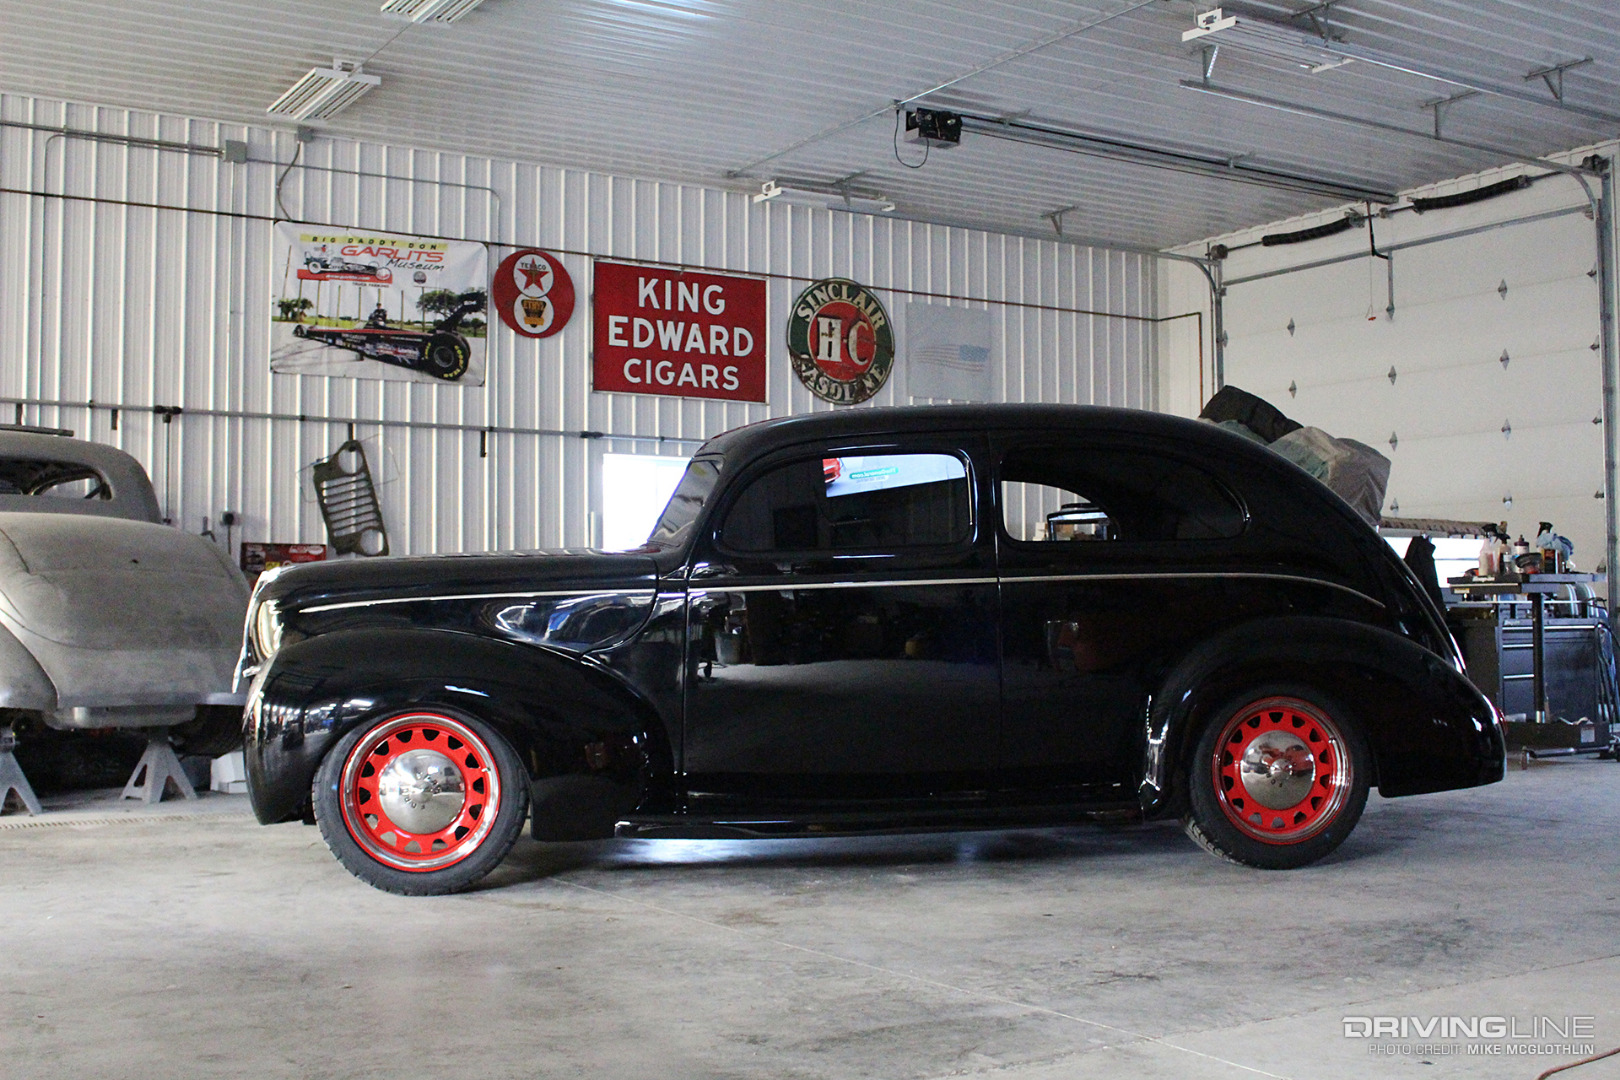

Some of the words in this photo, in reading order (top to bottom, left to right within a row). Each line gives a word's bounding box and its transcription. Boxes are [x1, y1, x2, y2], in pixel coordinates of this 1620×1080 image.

[340, 245, 444, 263] GARLITS
[347, 238, 397, 247] DADDY
[408, 242, 437, 250] DON
[386, 258, 445, 272] Museum
[520, 262, 547, 271] TEXACO
[638, 276, 726, 315] KING
[797, 283, 886, 331] SINCLAIR
[608, 315, 754, 357] EDWARD
[623, 358, 740, 391] CIGARS
[799, 354, 887, 402] ASOLNE
